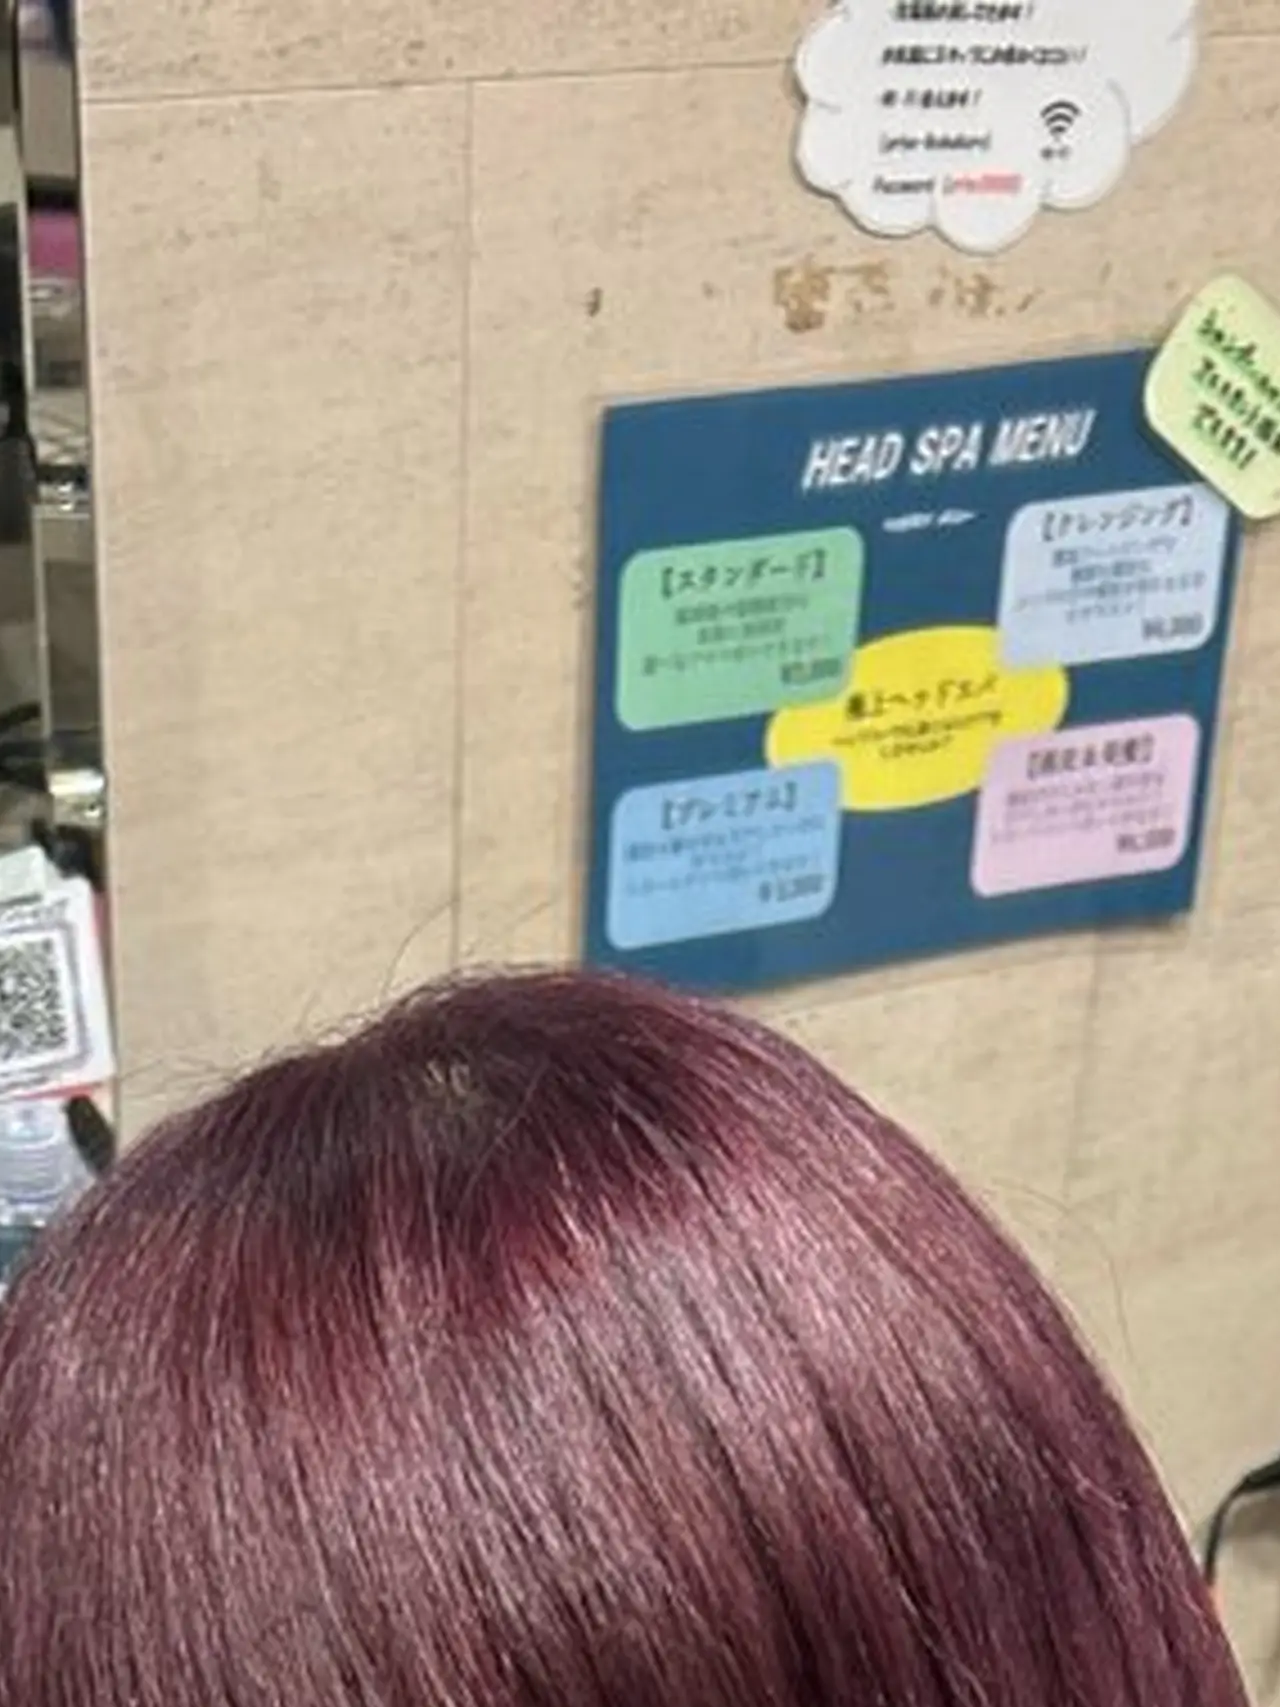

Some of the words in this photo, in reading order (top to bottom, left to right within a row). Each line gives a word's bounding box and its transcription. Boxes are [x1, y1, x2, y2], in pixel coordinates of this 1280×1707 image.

[801, 431, 906, 492] HEAD
[909, 421, 984, 477] SPA
[990, 408, 1098, 467] MENU
